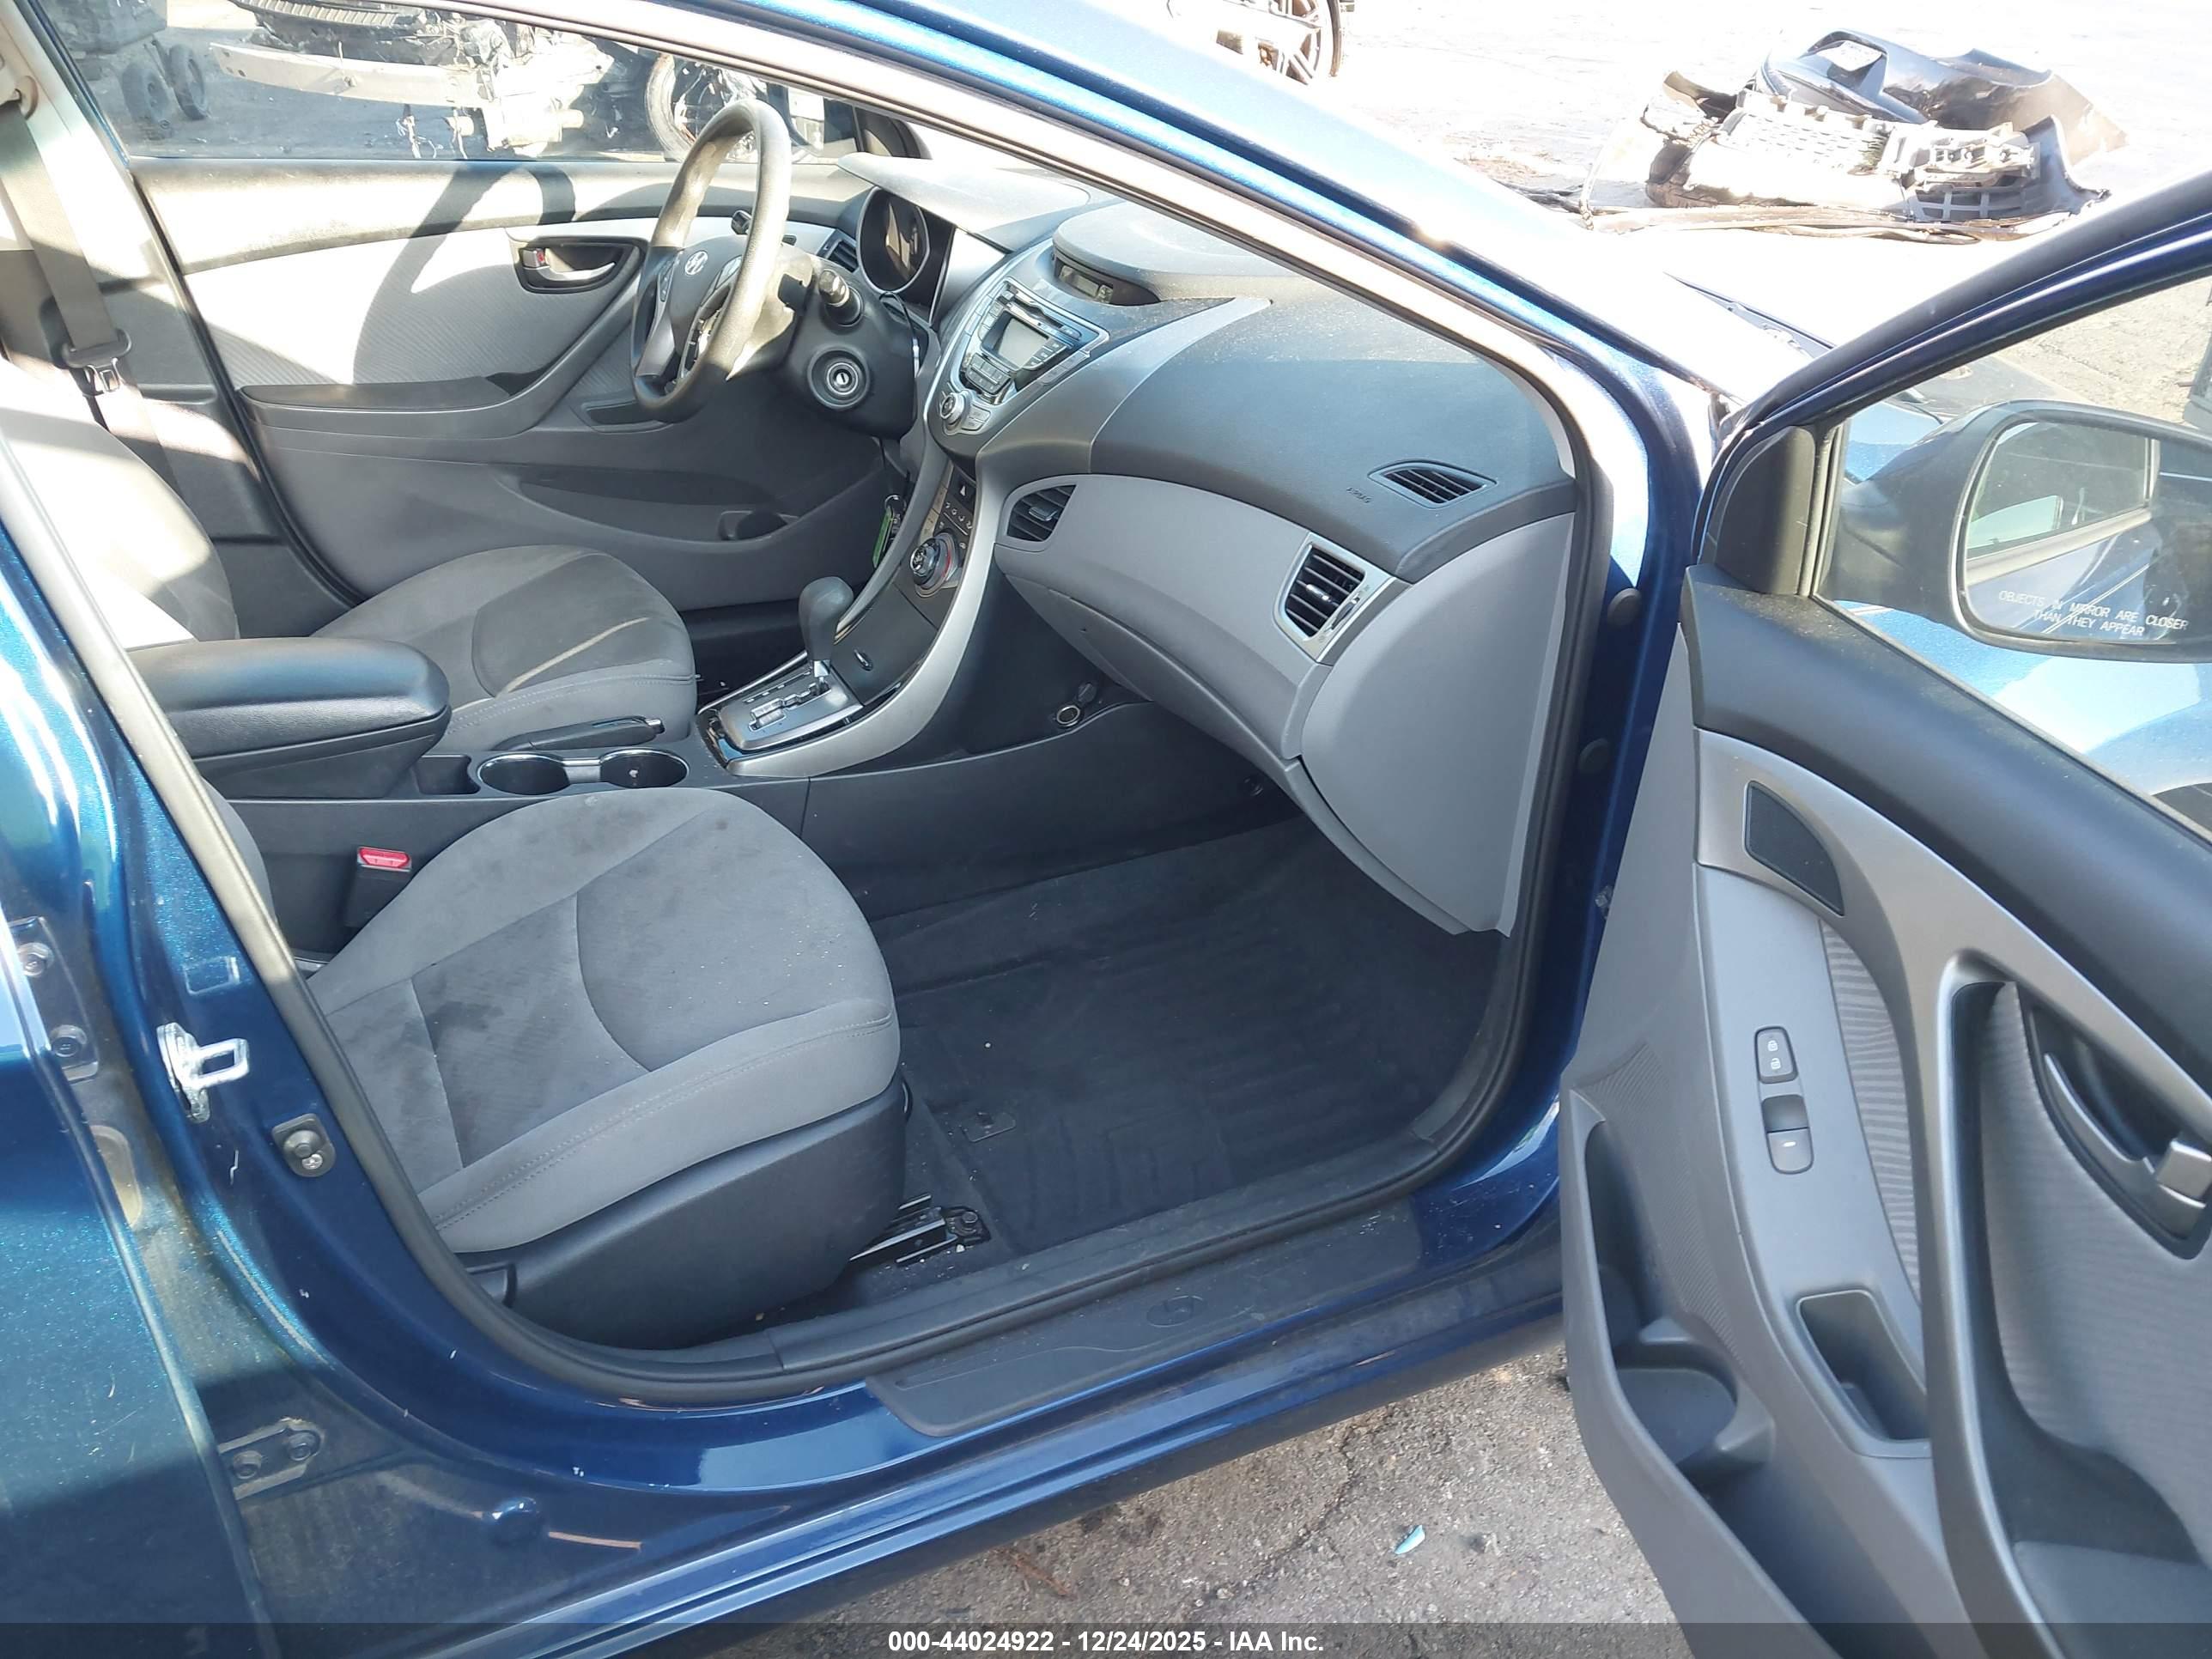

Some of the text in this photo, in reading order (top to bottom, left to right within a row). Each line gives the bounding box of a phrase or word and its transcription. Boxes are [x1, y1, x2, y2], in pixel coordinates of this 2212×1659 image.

[1997, 590, 2046, 607] OBJECTS
[2069, 602, 2111, 617] MIRROR
[2115, 610, 2140, 623] ARE
[2145, 615, 2189, 630] CLOSER
[2033, 609, 2145, 636] THAN THEY APPEAR
